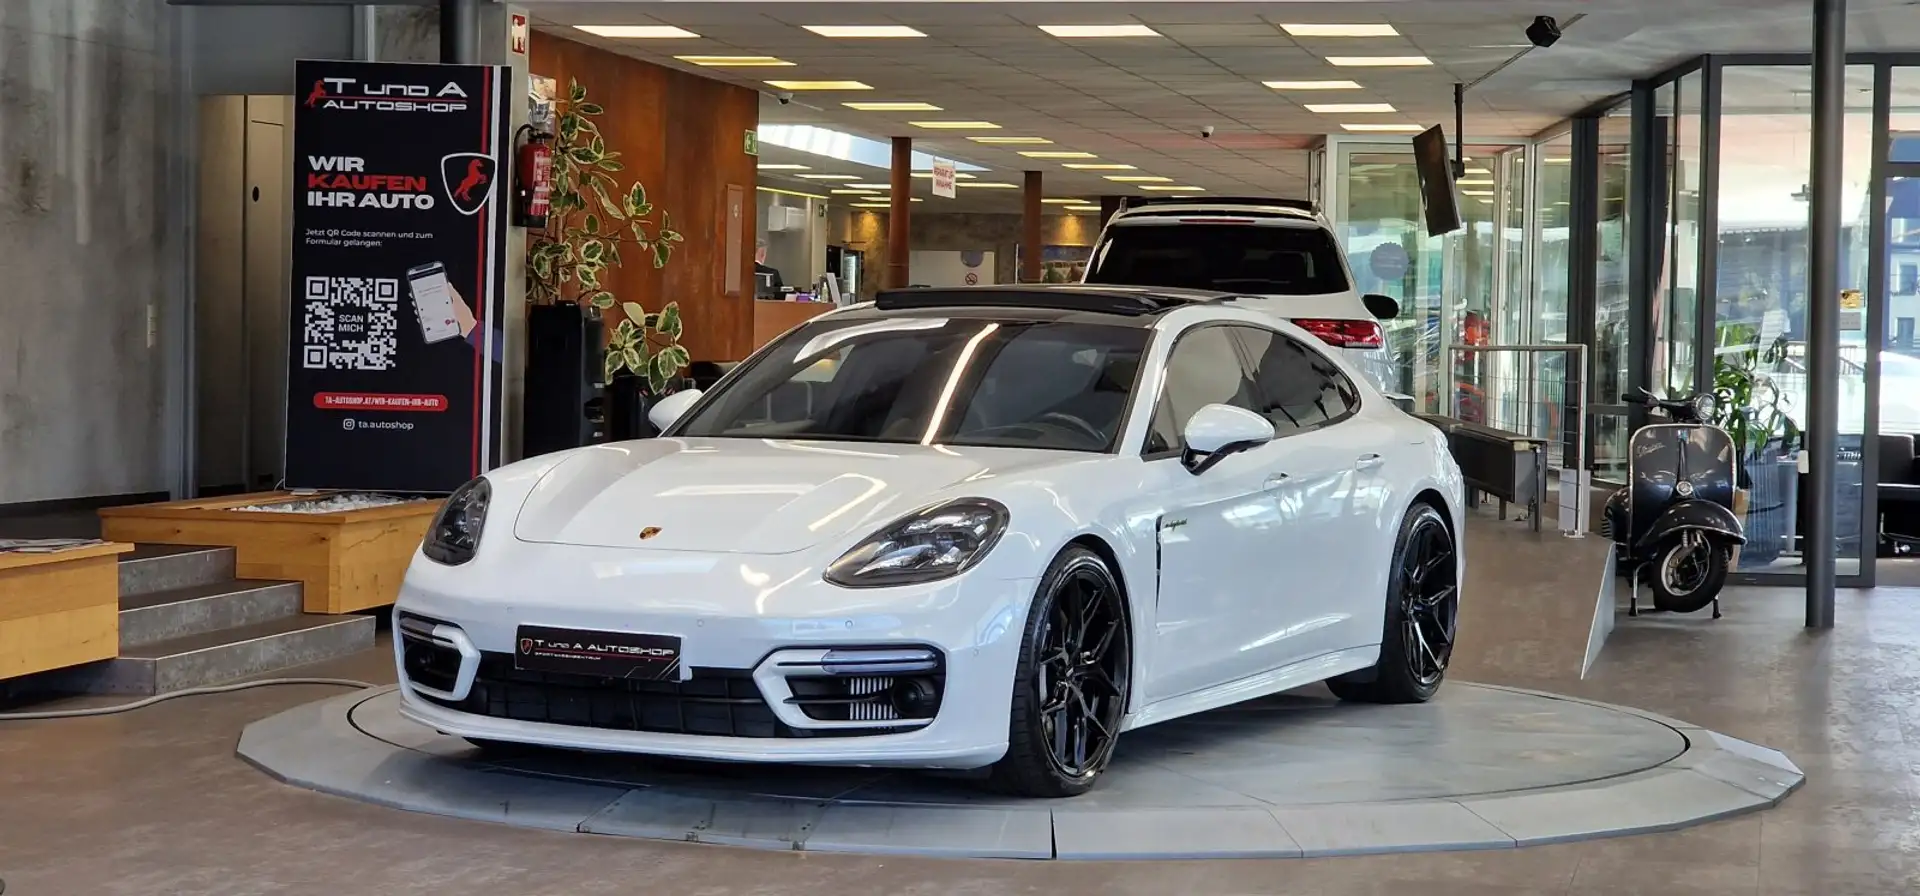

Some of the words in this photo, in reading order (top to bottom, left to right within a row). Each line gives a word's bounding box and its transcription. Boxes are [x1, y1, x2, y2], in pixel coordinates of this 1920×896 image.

[324, 77, 356, 94] T
[436, 82, 468, 98] A
[323, 100, 467, 113] AUTOSHOP
[307, 155, 365, 172] WIR
[307, 173, 427, 192] KAUFEN
[307, 191, 356, 207] IHR
[358, 194, 435, 210] AUTO
[305, 228, 325, 237] Jetzt
[326, 229, 340, 238] QR
[341, 230, 361, 238] Code
[398, 231, 414, 239] und
[305, 237, 341, 246] Formular
[343, 239, 383, 249] gelangen:
[338, 314, 364, 323] SCAN
[338, 323, 364, 333] MICH
[358, 420, 414, 431] ta.autoshop
[534, 639, 545, 647] T
[587, 643, 674, 656] AUTOSHOP
